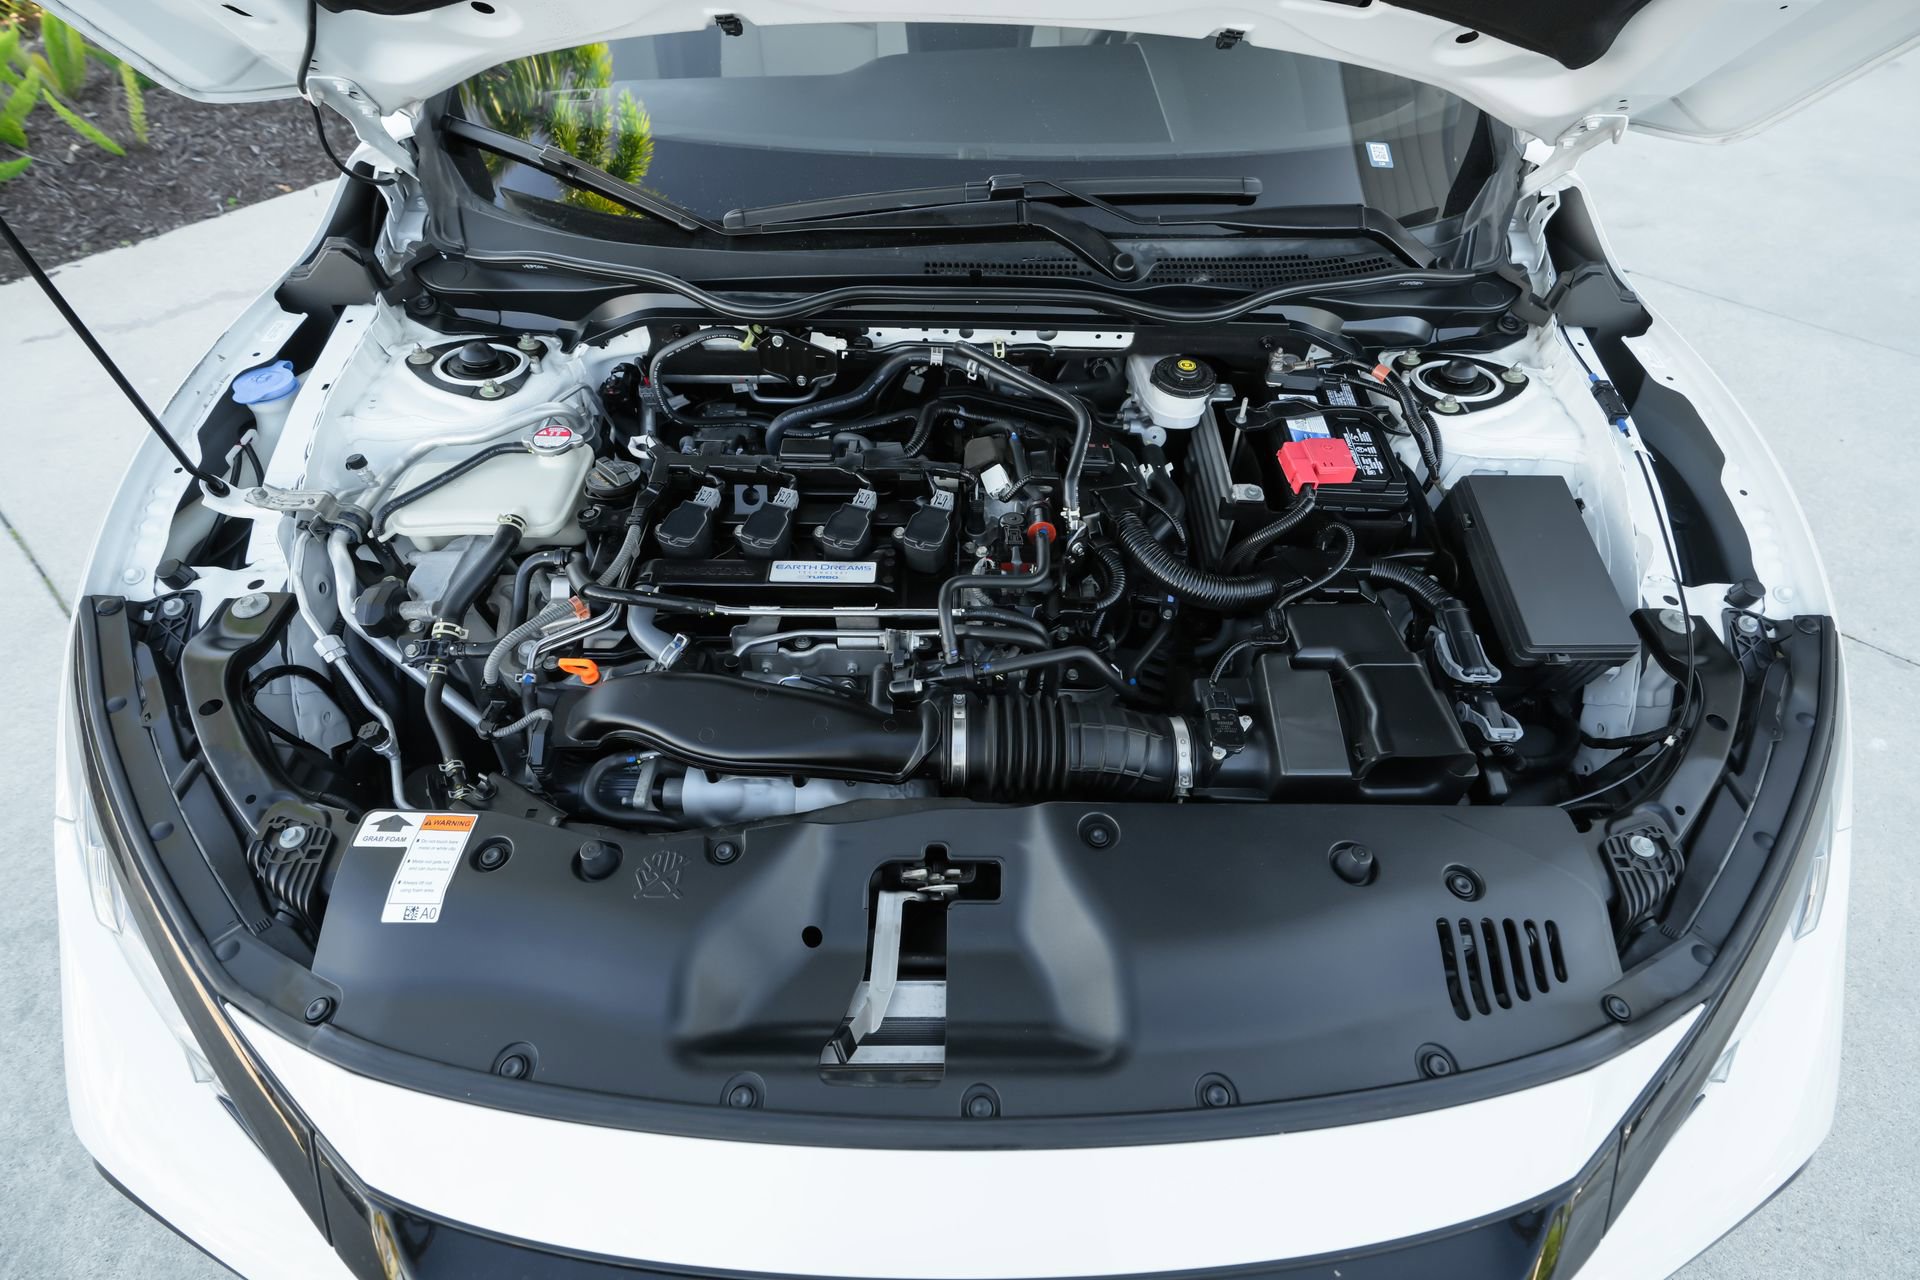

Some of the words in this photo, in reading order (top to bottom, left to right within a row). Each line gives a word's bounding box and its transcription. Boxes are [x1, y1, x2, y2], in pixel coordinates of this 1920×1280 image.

[820, 563, 872, 571] DREAMS
[433, 819, 471, 827] WARNING
[419, 906, 437, 920] A0
